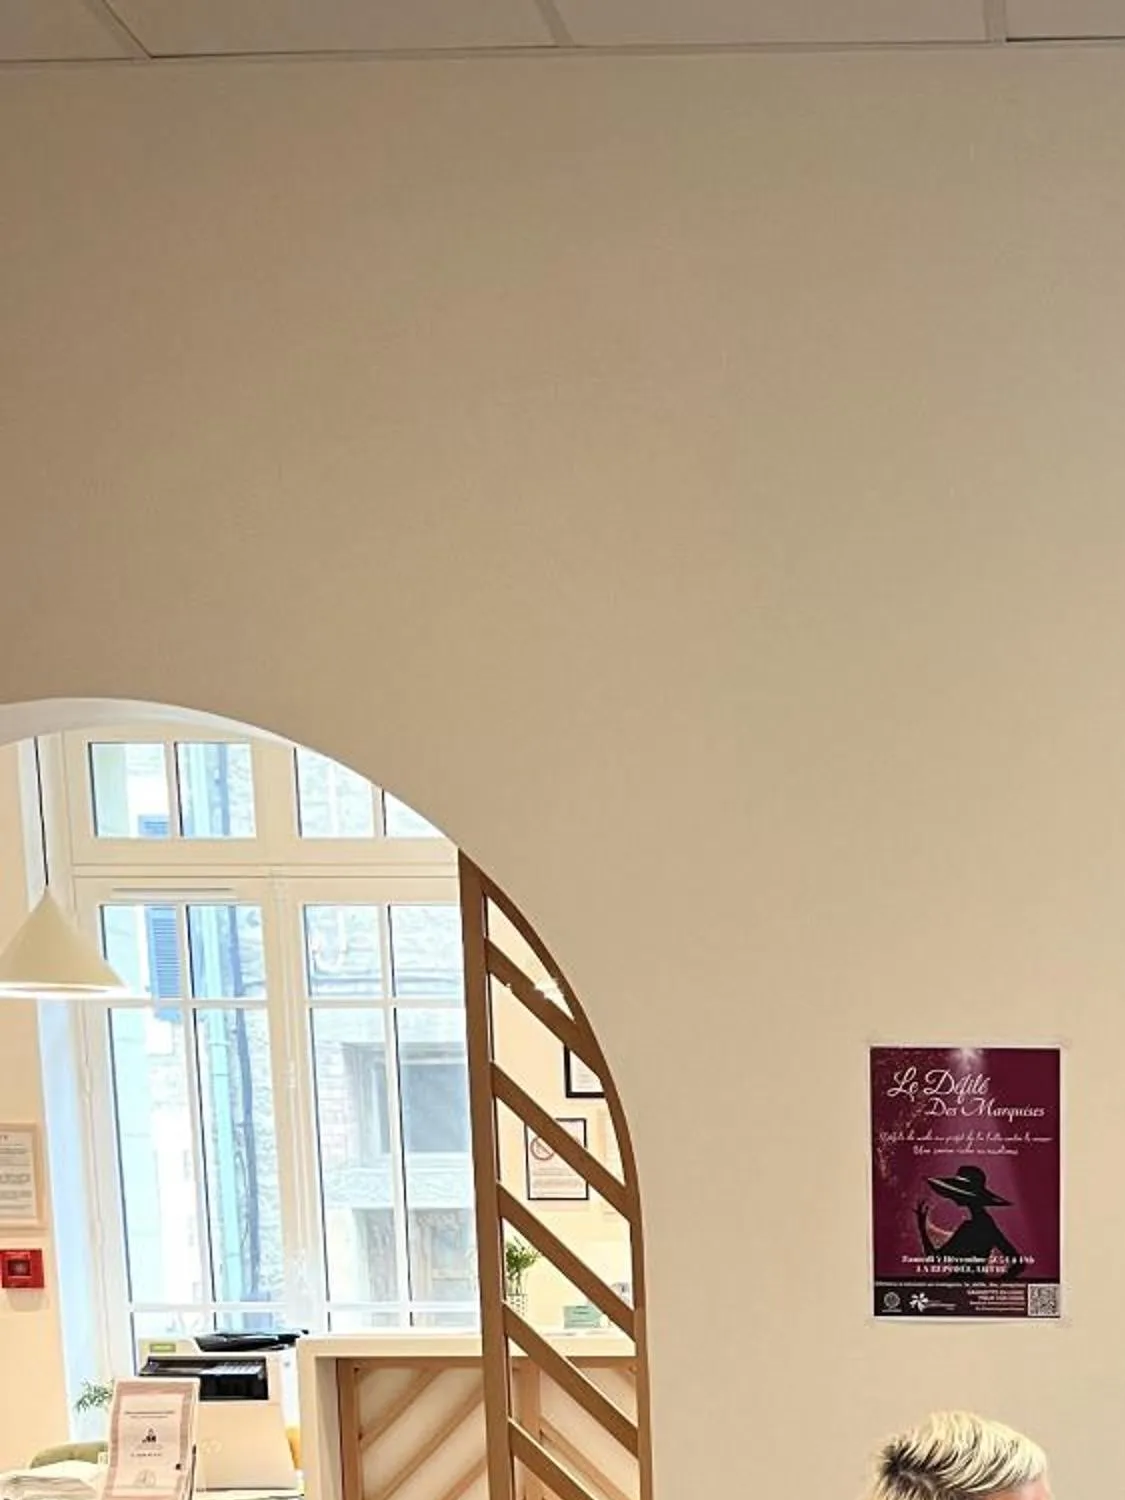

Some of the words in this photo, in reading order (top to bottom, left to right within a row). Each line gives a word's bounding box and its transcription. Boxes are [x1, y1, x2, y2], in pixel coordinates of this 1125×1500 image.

[887, 1065, 919, 1102] Le
[924, 1097, 957, 1117] Des
[961, 1097, 1046, 1123] Marquises
